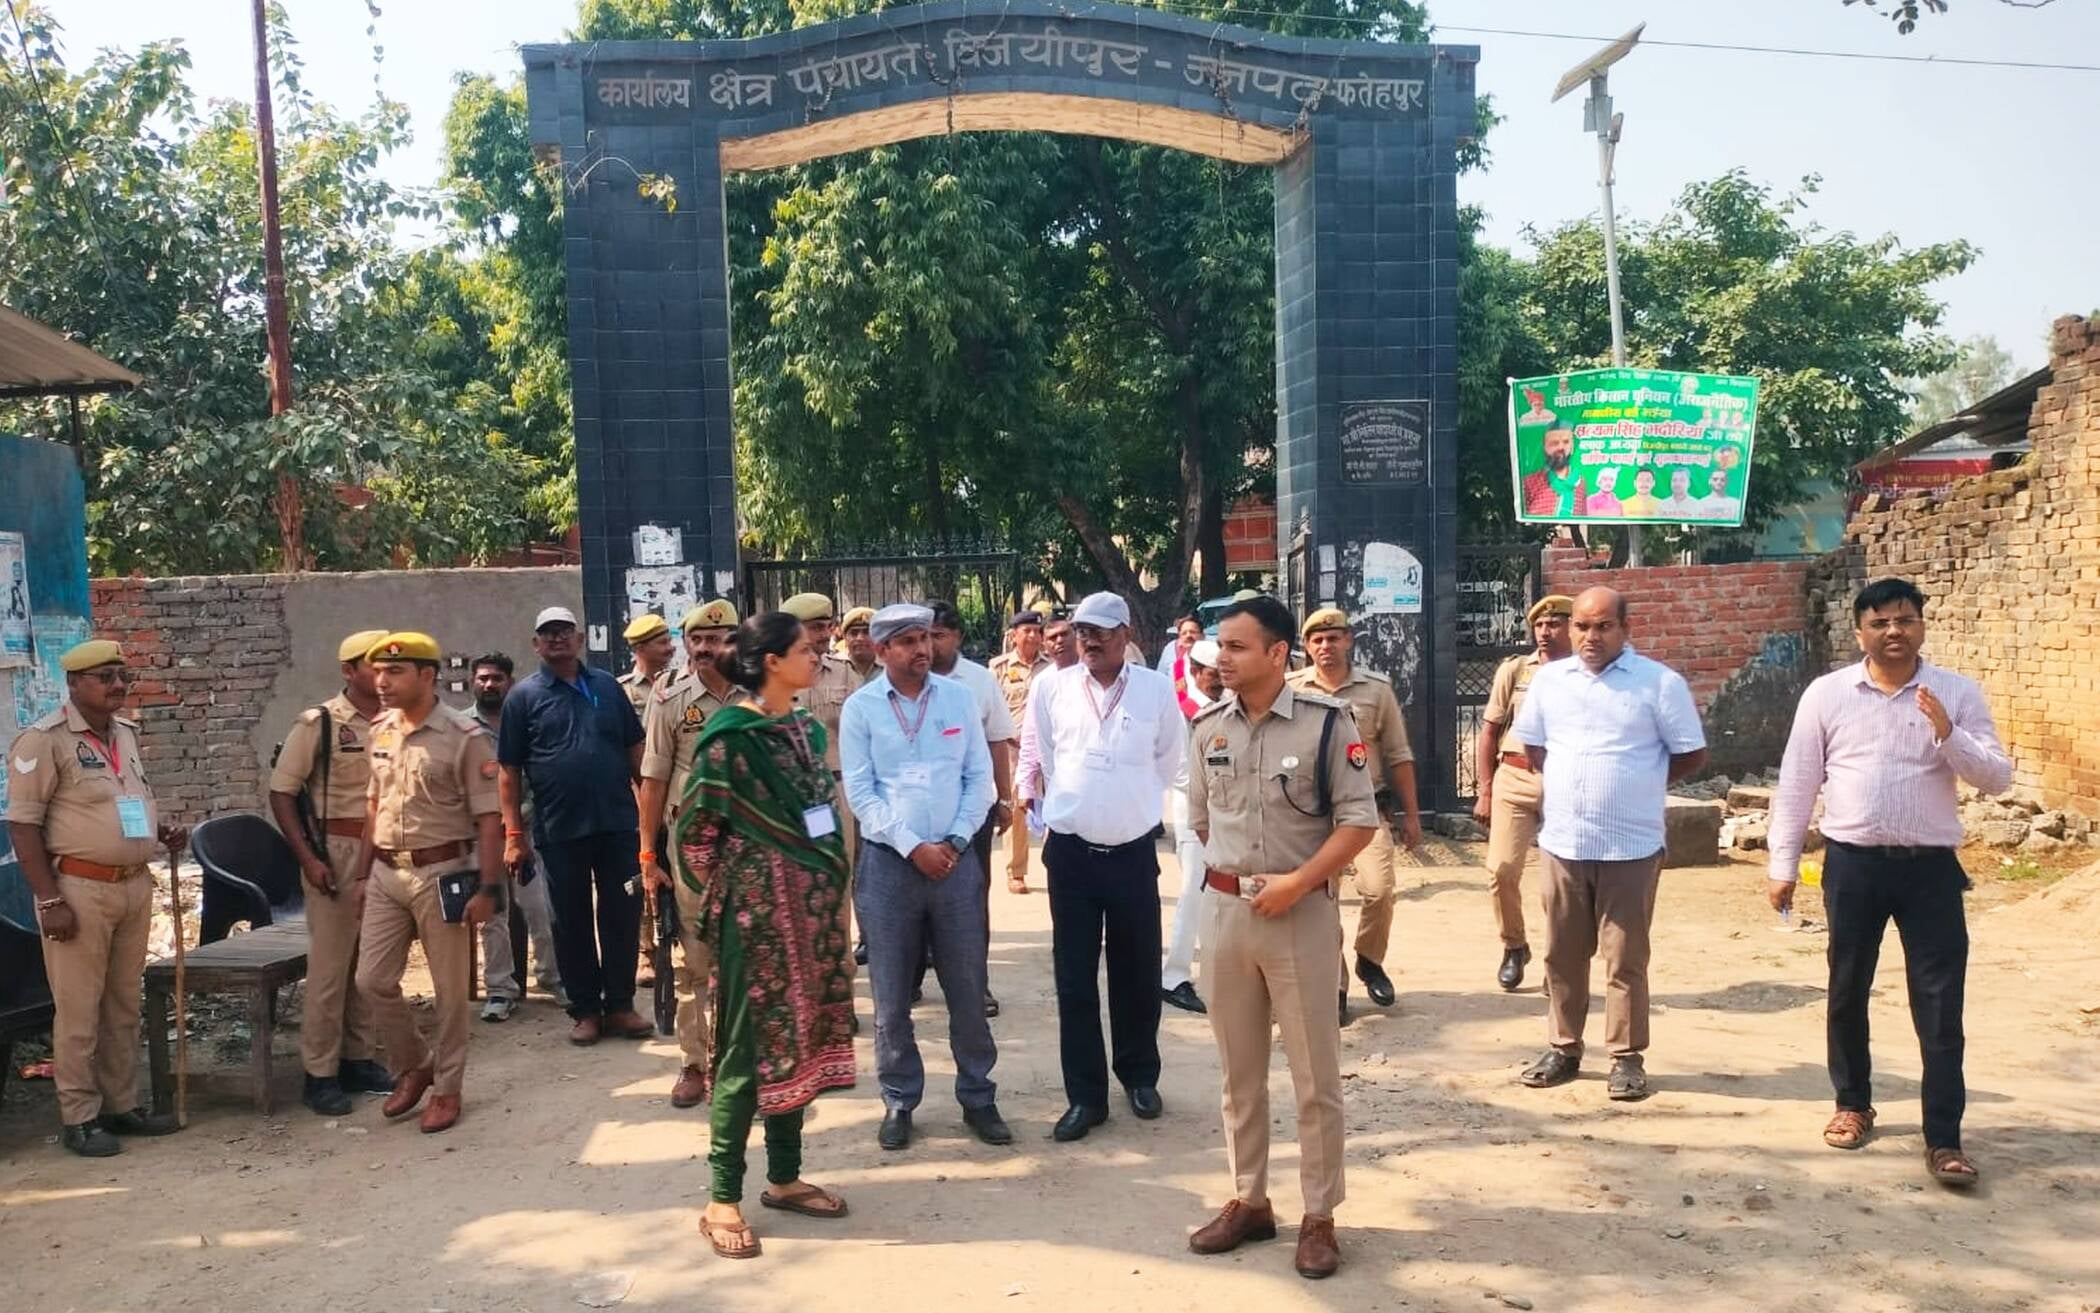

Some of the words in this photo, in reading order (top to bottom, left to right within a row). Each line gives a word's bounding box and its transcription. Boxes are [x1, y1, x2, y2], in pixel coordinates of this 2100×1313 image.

[598, 69, 691, 108] कार्यालय
[709, 68, 777, 110] क्षेत्र
[787, 42, 923, 95] पंचायत
[943, 25, 1148, 77] विजयीपुर
[1333, 71, 1425, 111] फतेहपुर
